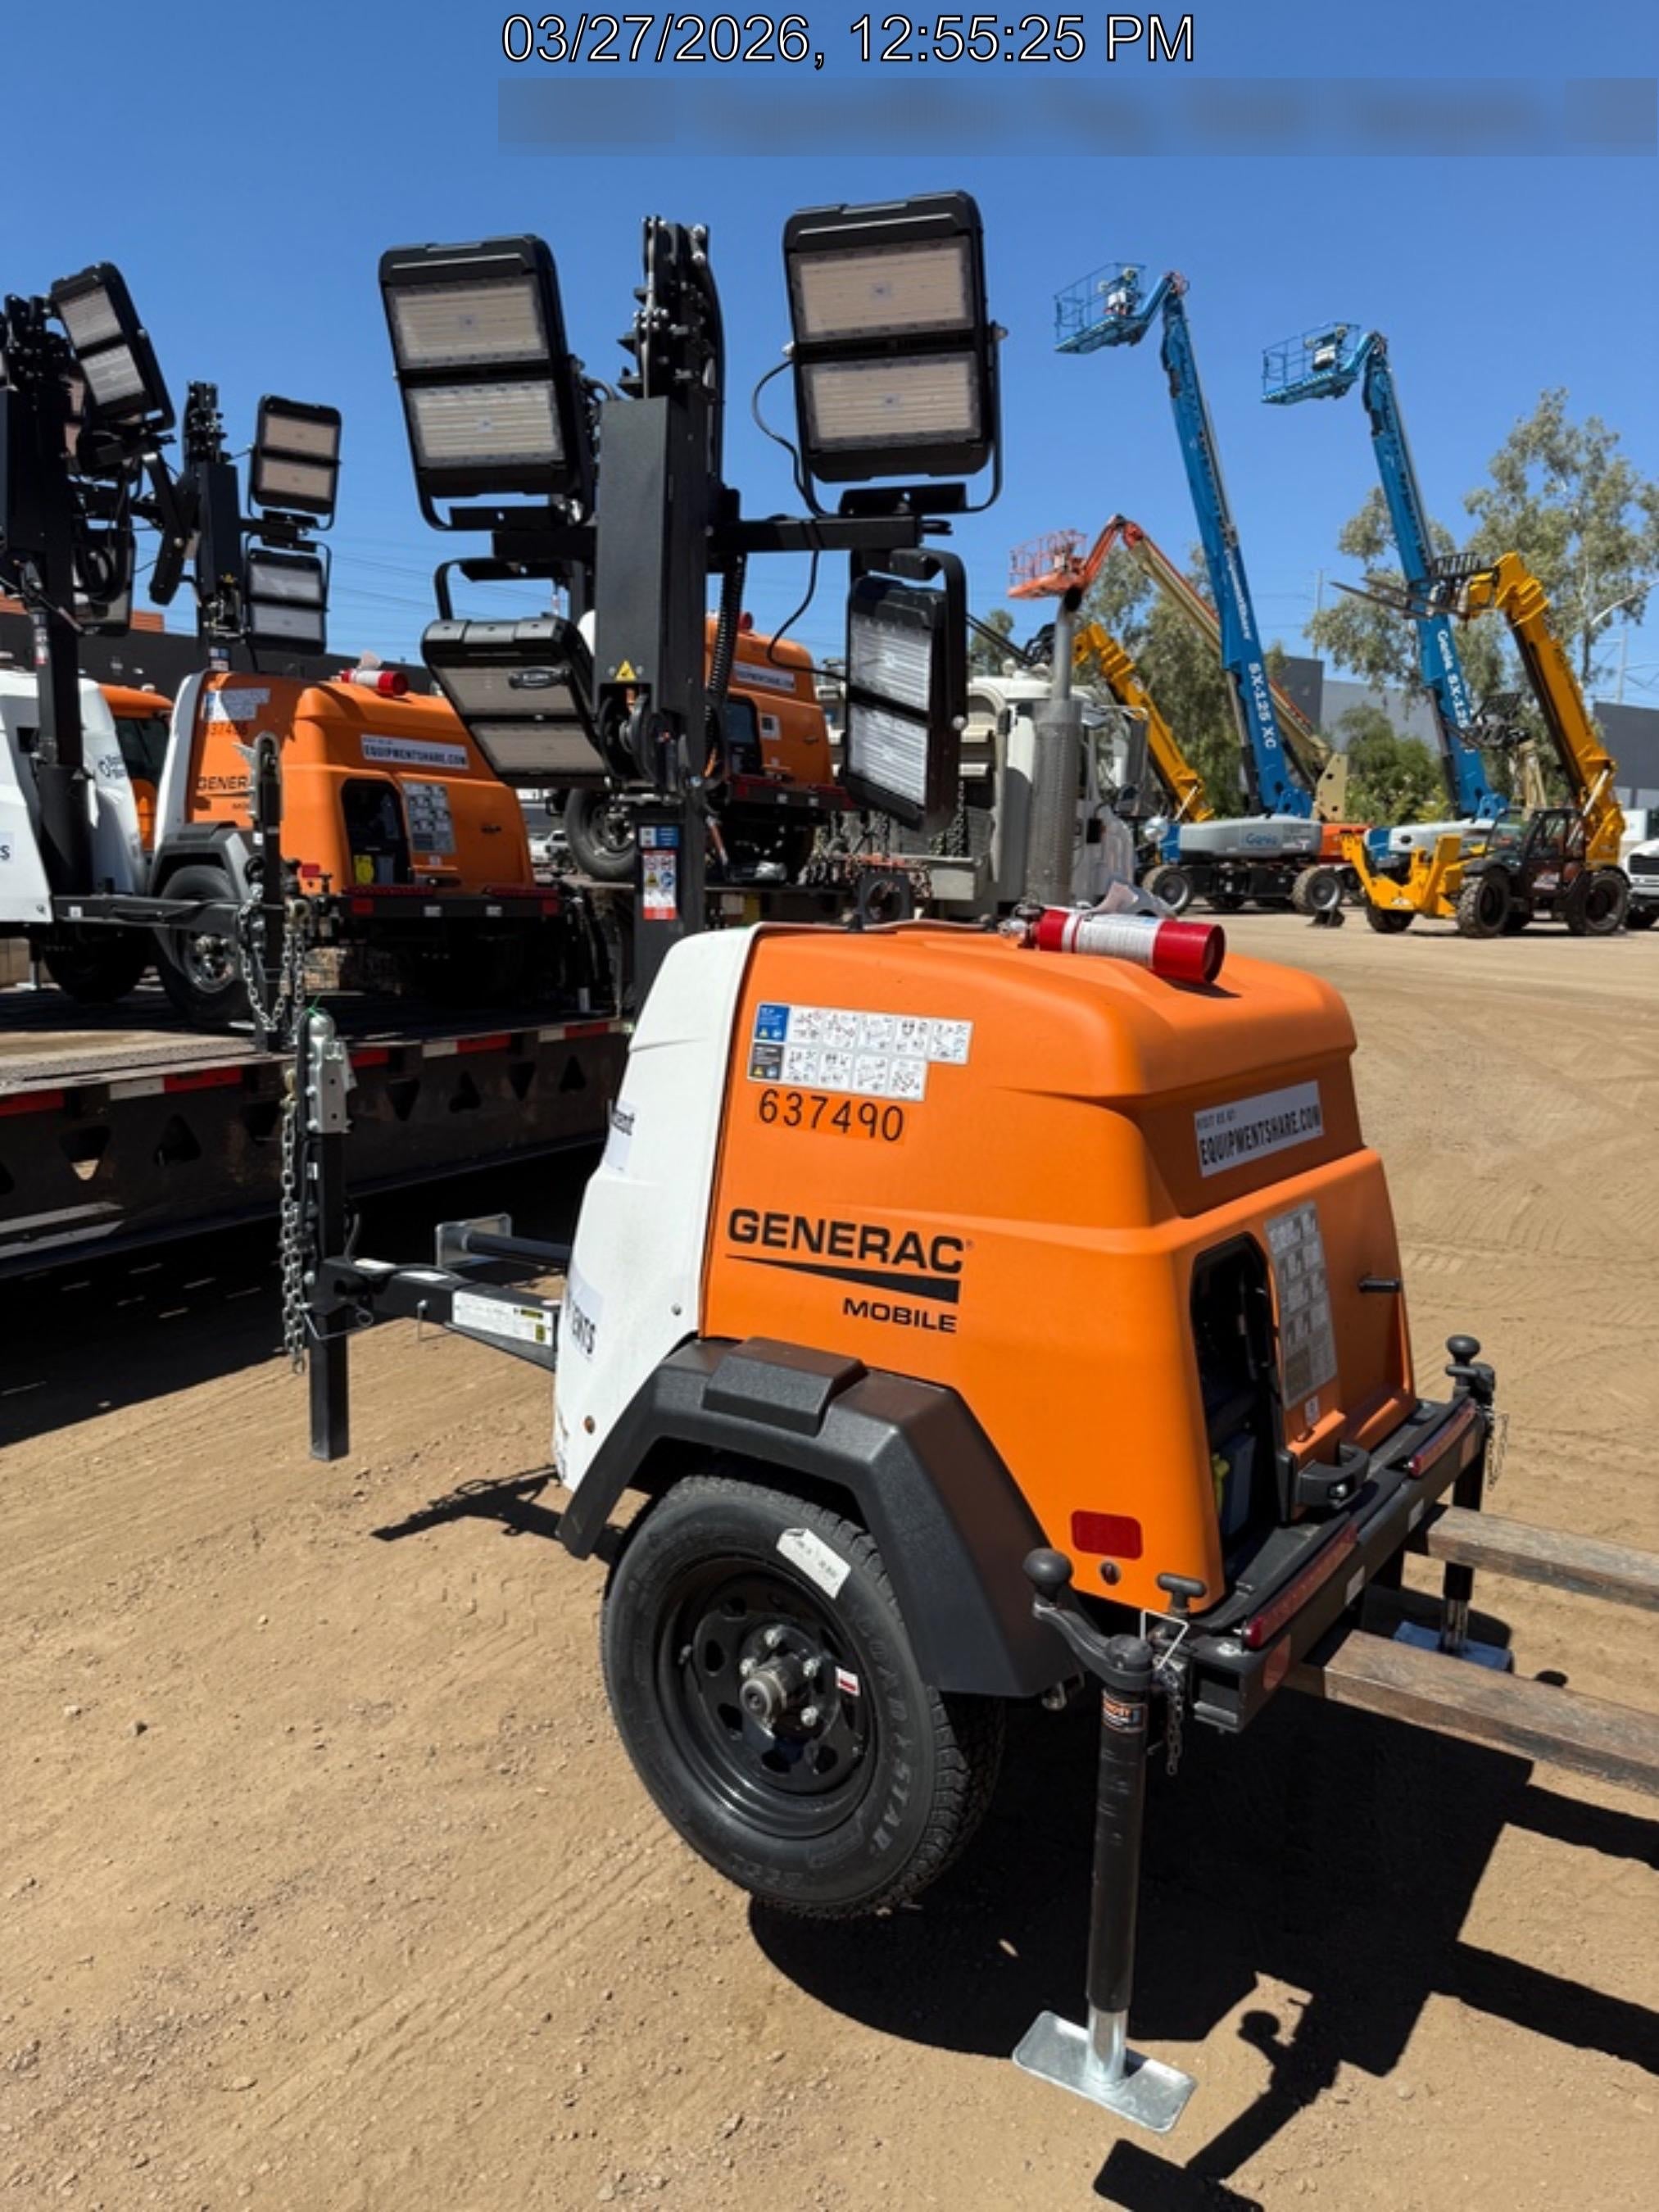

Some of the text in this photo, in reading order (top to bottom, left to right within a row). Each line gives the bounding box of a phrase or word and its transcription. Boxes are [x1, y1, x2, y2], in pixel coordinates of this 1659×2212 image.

[197, 776, 248, 791] GENER
[759, 1088, 904, 1142] 637490
[728, 1207, 964, 1274] GENERAC
[842, 1296, 957, 1333] MOBILE
